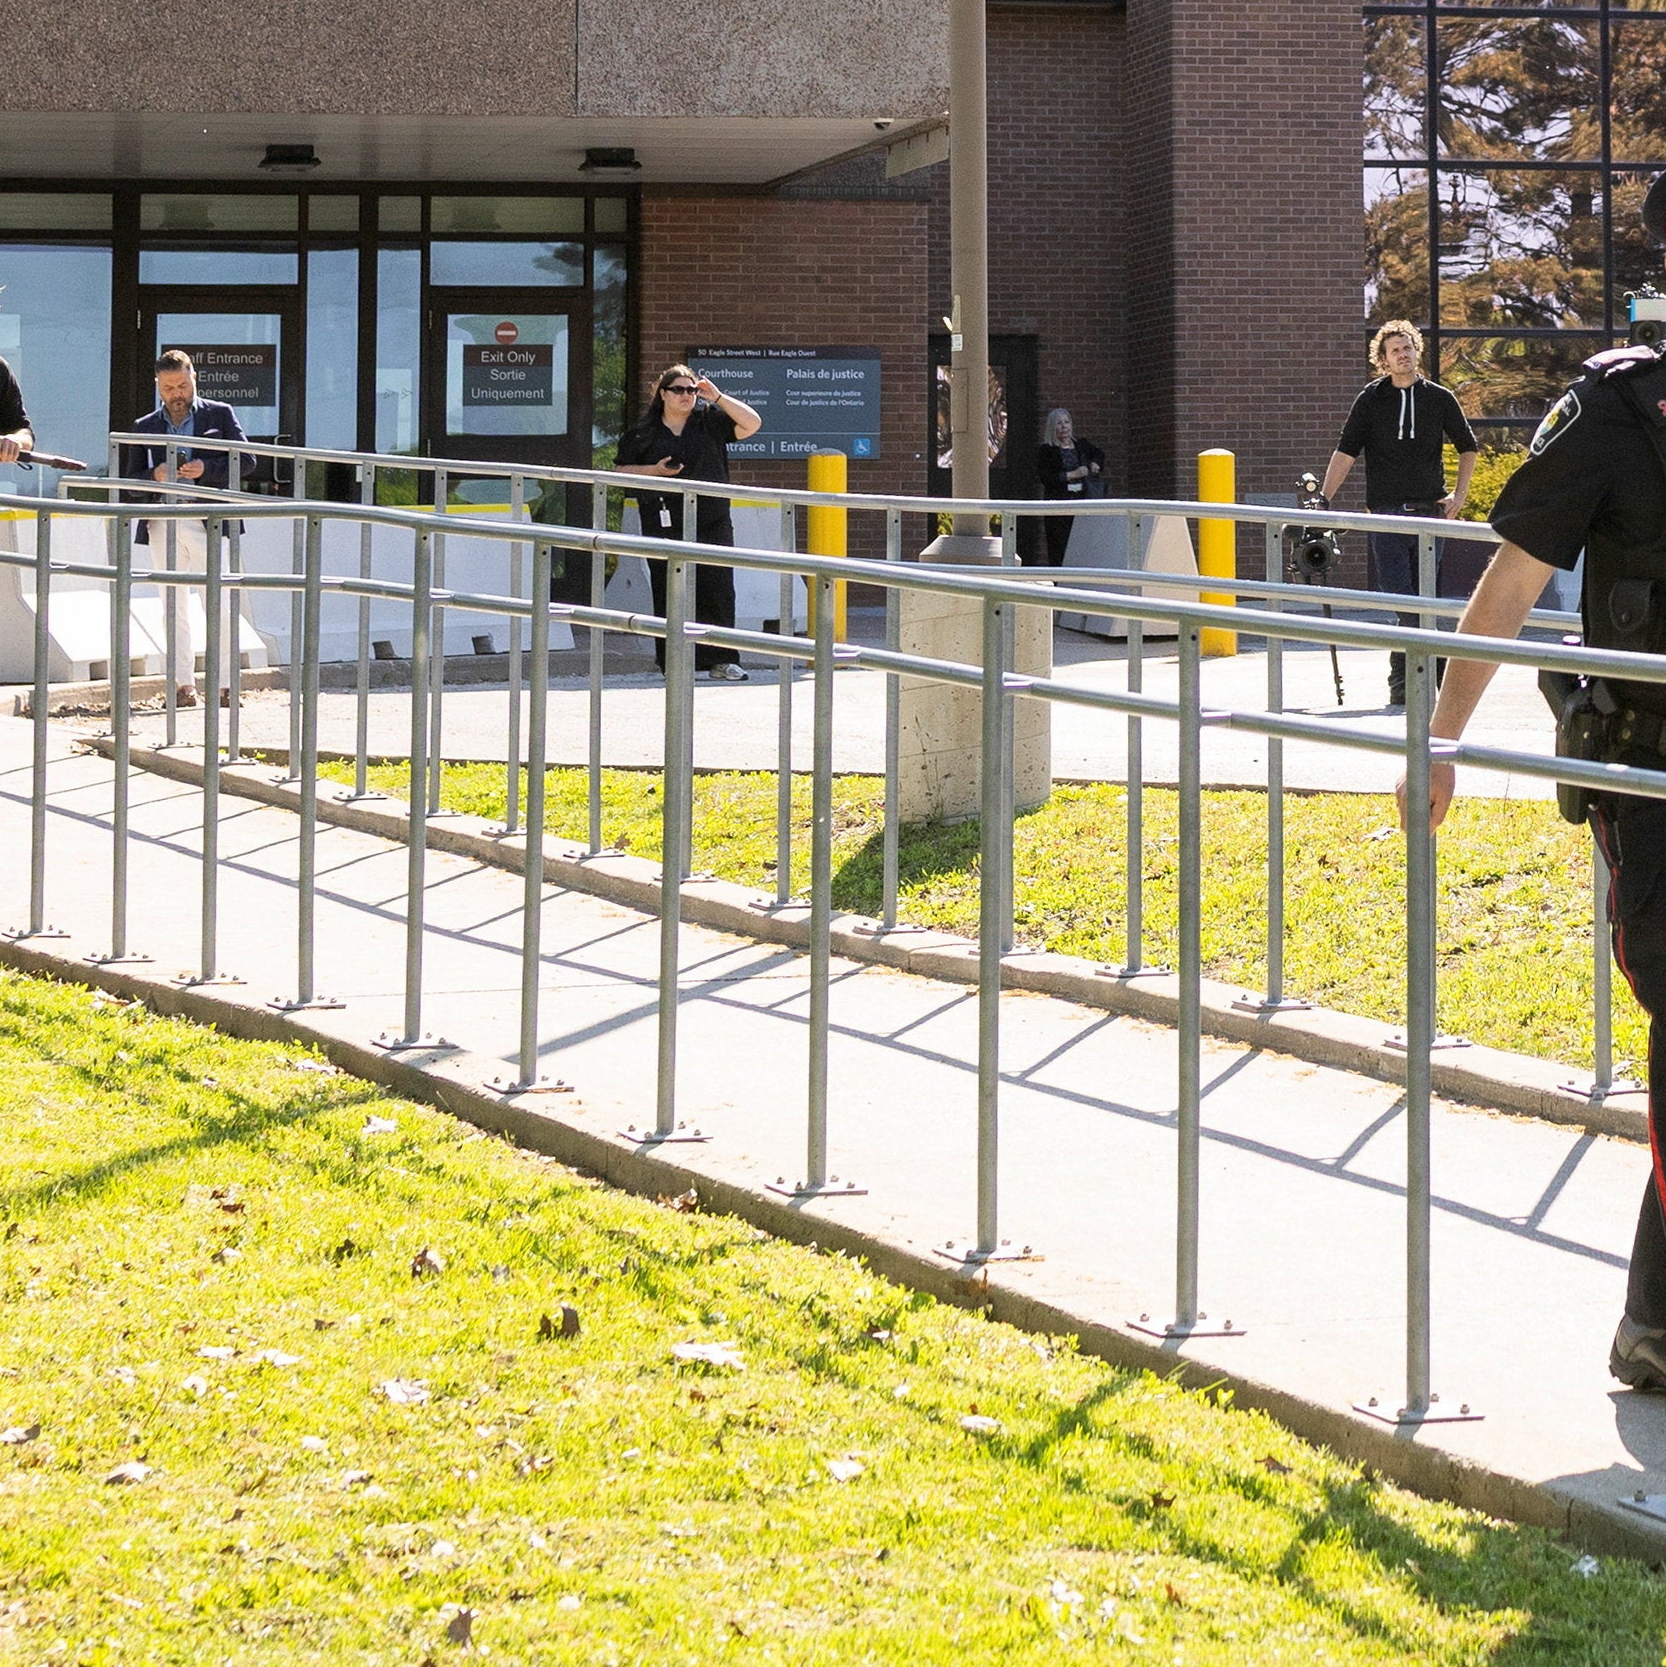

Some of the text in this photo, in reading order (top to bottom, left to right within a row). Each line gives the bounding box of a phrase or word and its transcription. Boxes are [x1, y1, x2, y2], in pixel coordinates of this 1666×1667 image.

[192, 353, 263, 365] aff Entrance
[481, 351, 536, 366] Exit Only
[709, 349, 726, 357] Eagle
[781, 349, 797, 357] Eagle
[198, 370, 240, 382] Entrée
[490, 368, 526, 380] Sortie
[697, 368, 754, 379] Courthouse
[786, 368, 865, 380] Palais de justice
[471, 388, 544, 401] Uniquement
[785, 389, 800, 397] Cour
[725, 441, 818, 452] ntrance Entrée
